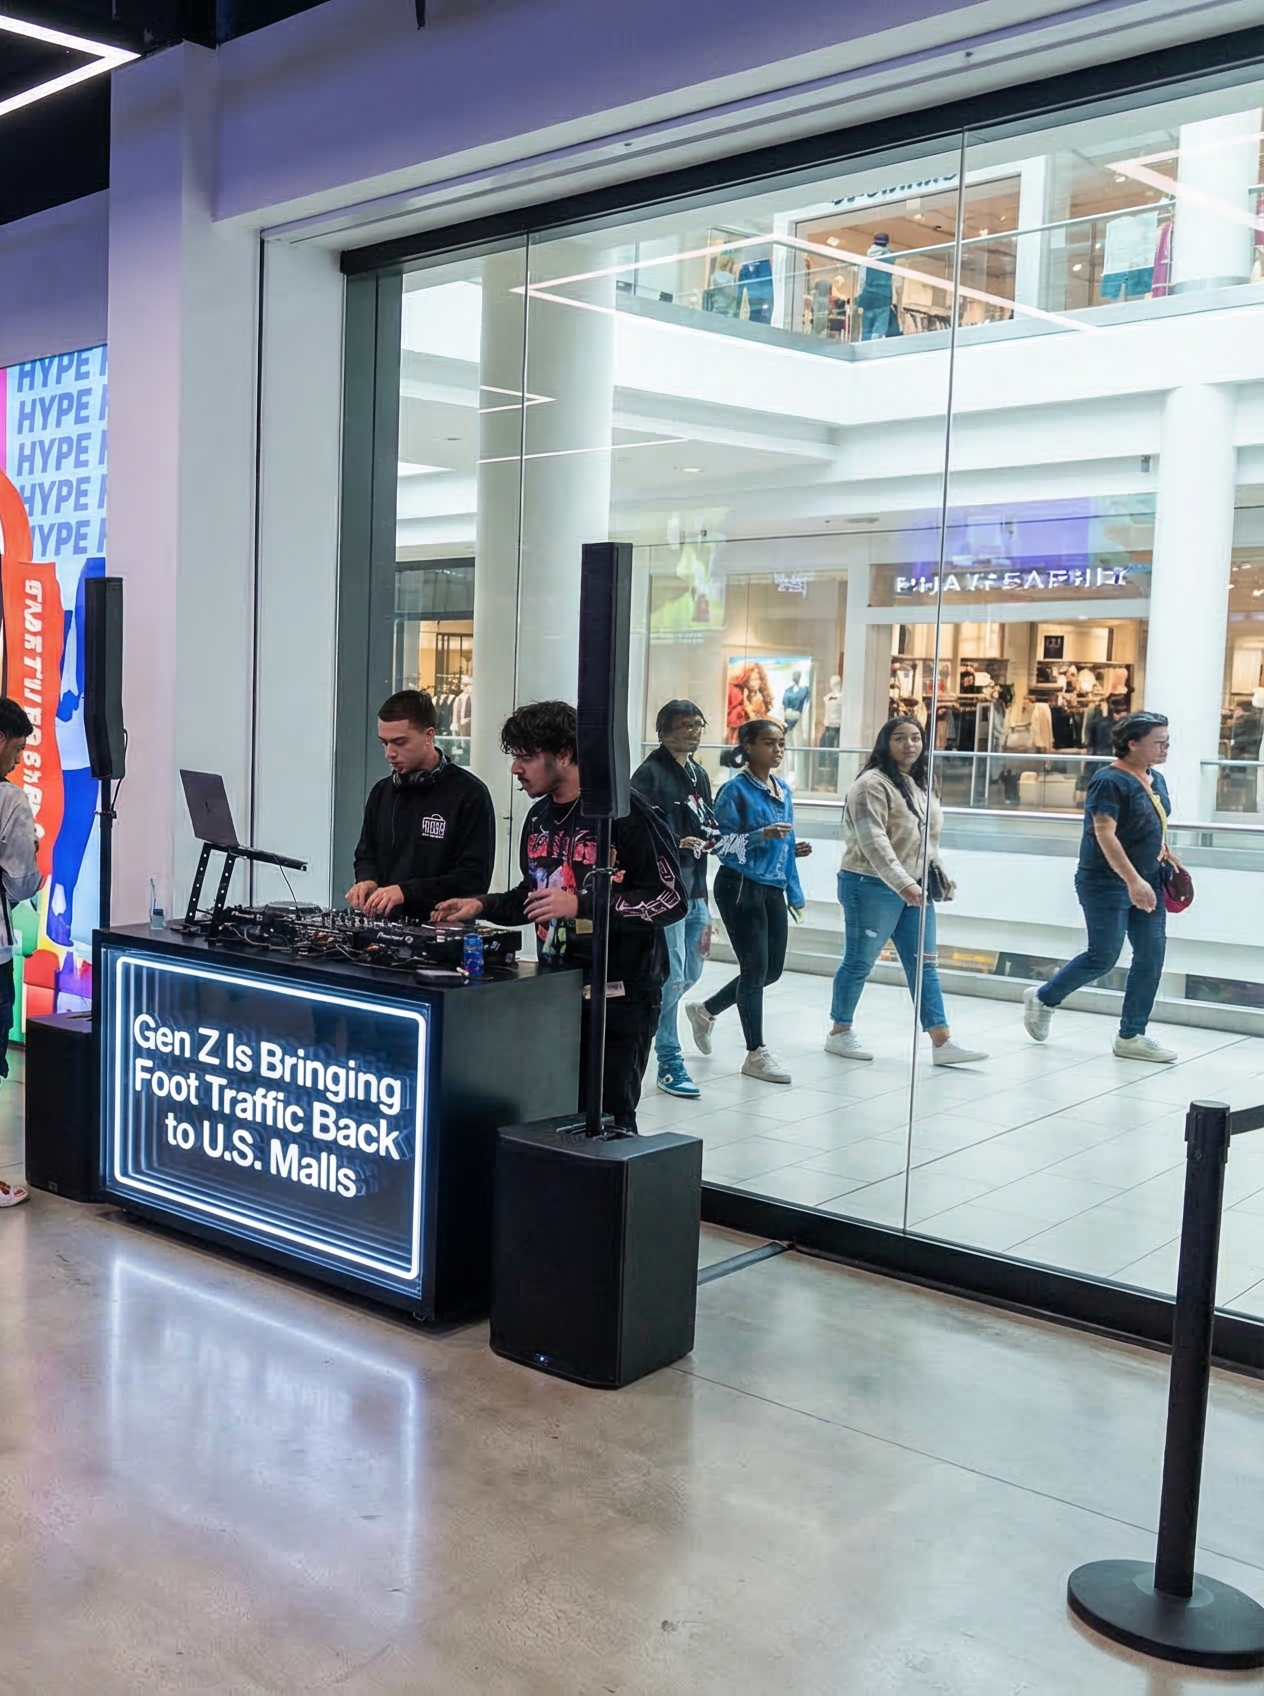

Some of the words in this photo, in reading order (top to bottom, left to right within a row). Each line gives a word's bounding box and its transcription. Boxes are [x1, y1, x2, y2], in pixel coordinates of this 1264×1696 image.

[17, 351, 90, 393] HYPE
[17, 388, 92, 435] HYPE
[17, 432, 91, 477] HYPE
[19, 476, 91, 517] HYPE
[133, 1013, 191, 1059] Gen
[197, 1027, 220, 1065] Z
[226, 1032, 253, 1073] Is
[260, 1040, 402, 1115] Bringing
[135, 1059, 200, 1106] Foot
[205, 1073, 304, 1133] Traffic
[312, 1101, 401, 1160] Back
[165, 1112, 195, 1150] to
[202, 1120, 262, 1171] U.S.
[270, 1138, 358, 1198] Malls
